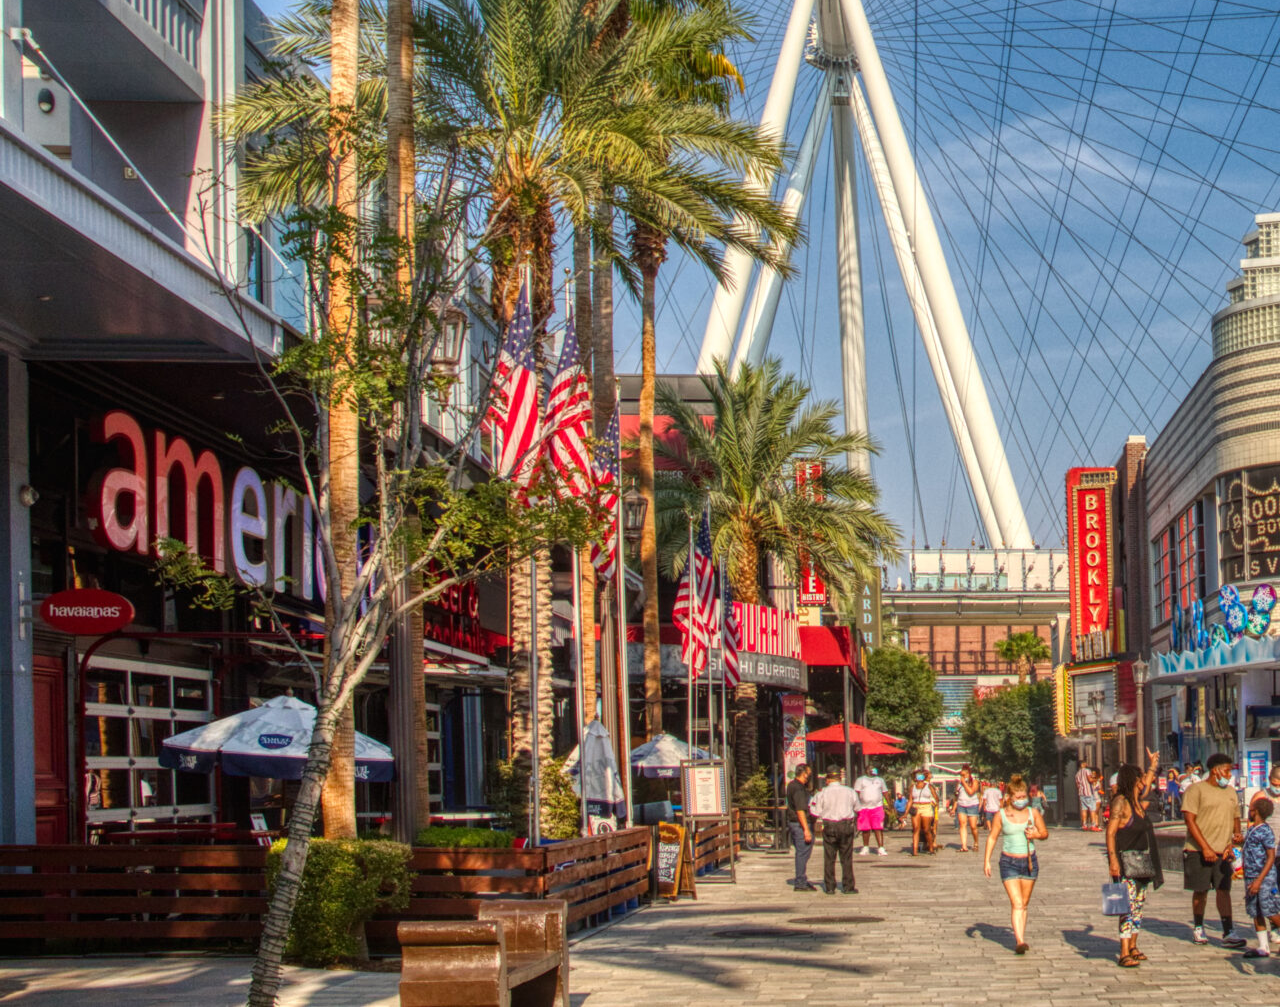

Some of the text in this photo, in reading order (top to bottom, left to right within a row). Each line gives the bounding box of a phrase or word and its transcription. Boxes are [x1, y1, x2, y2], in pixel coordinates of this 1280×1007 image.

[802, 593, 824, 601] BISTRO
[863, 584, 873, 625] ARD
[49, 603, 120, 619] havaianas
[711, 658, 800, 679] SHI BURRITOS
[785, 750, 806, 758] POPS
